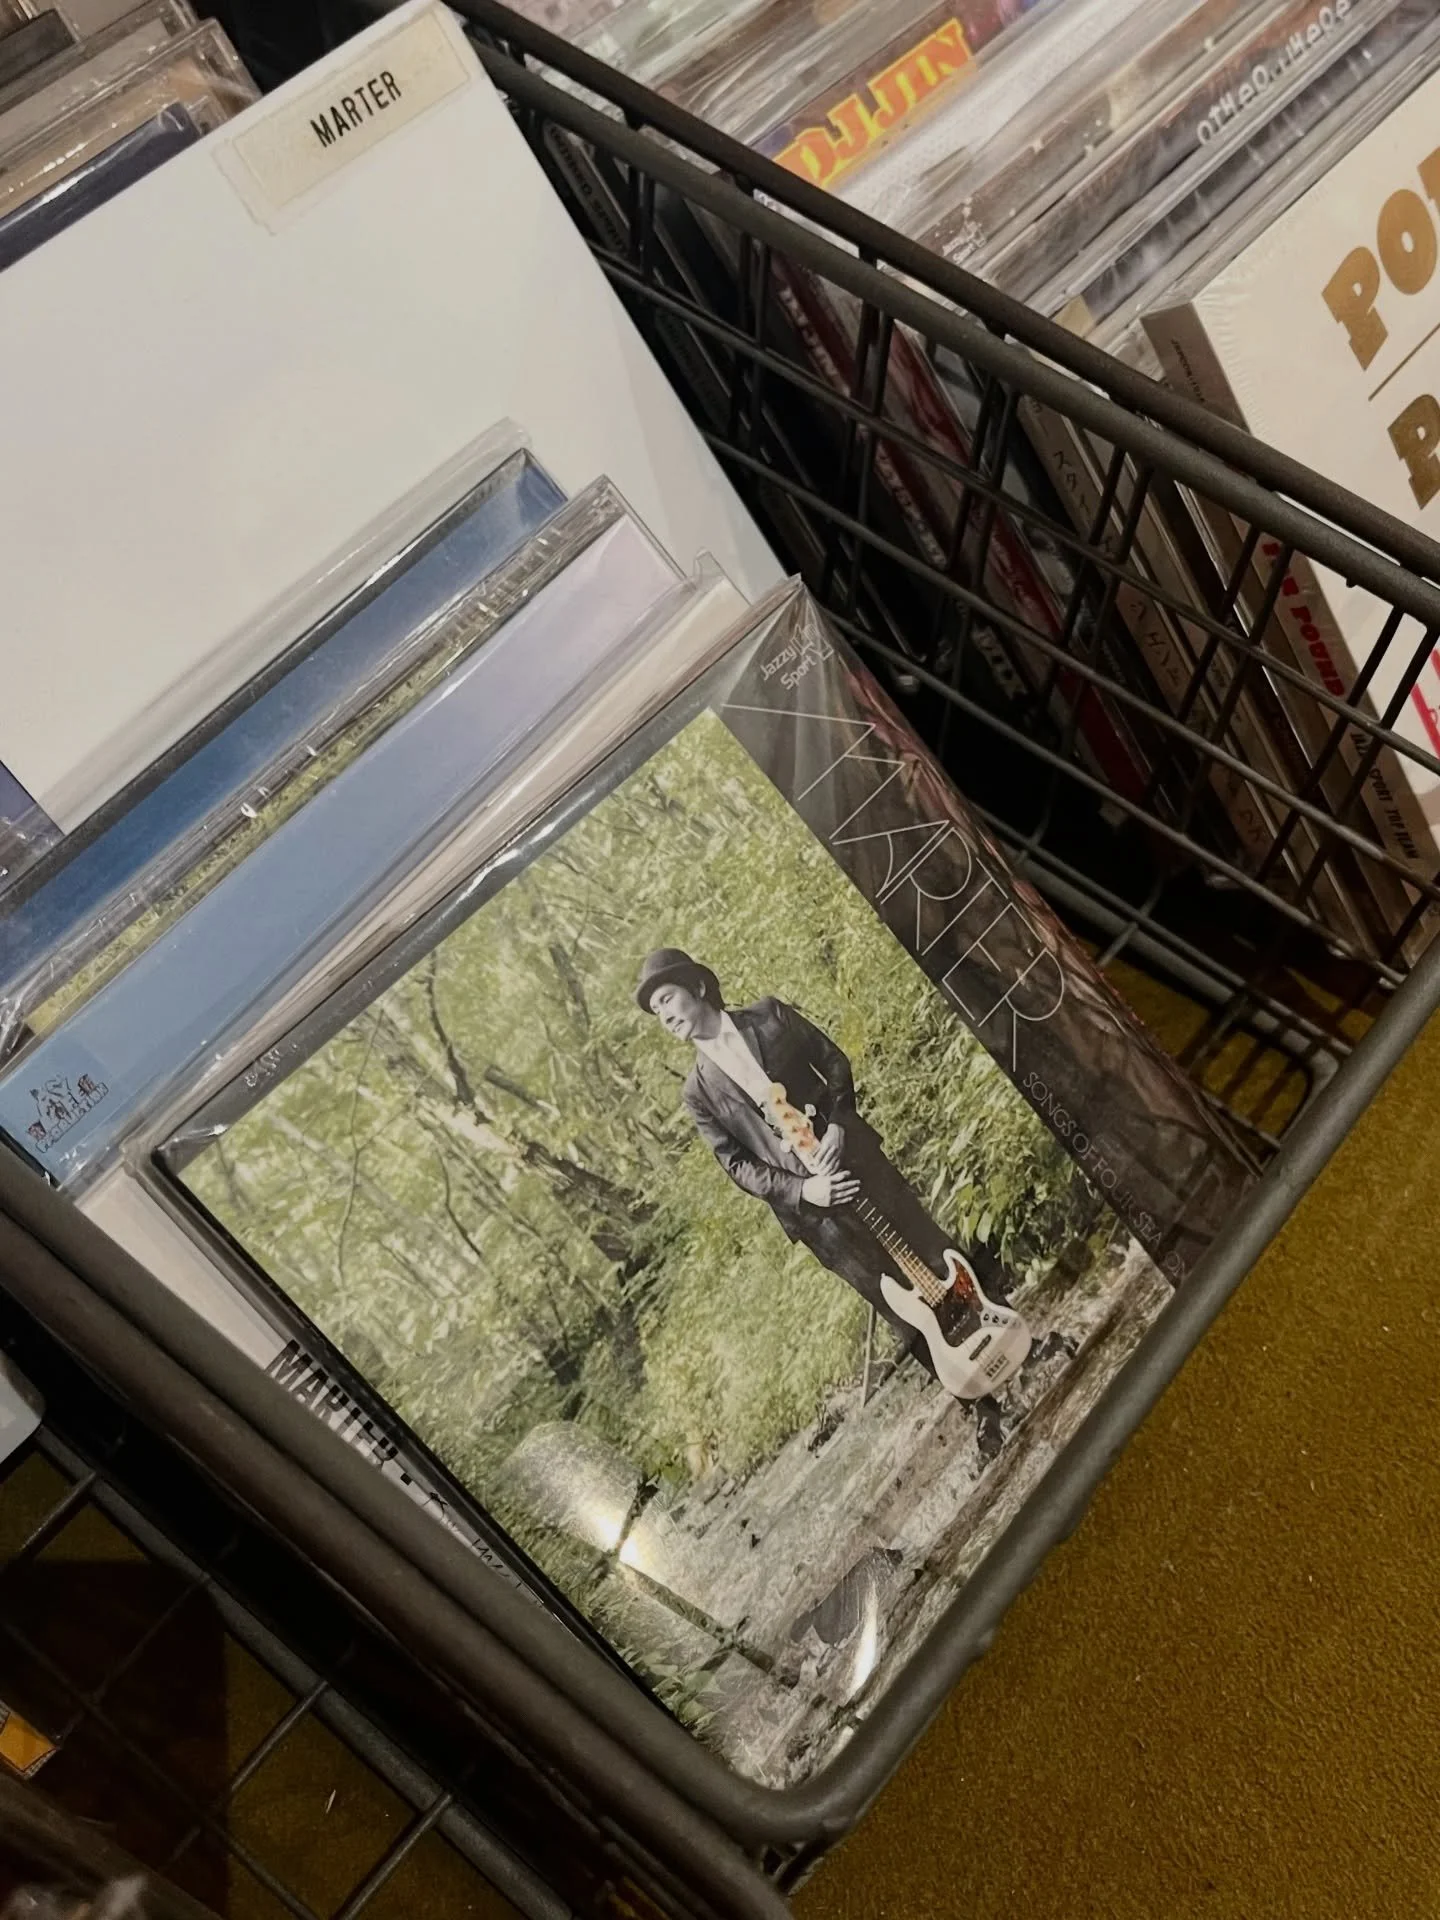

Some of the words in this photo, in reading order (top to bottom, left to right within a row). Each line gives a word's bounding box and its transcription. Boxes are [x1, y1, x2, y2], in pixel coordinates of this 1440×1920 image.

[310, 71, 402, 148] MARTER
[760, 645, 798, 681] Jazzy
[780, 655, 817, 691] Sport
[1290, 605, 1346, 697] POUND
[721, 702, 1065, 1073] MARTER
[1022, 1071, 1078, 1137] SONGS
[1072, 1132, 1099, 1161] OF
